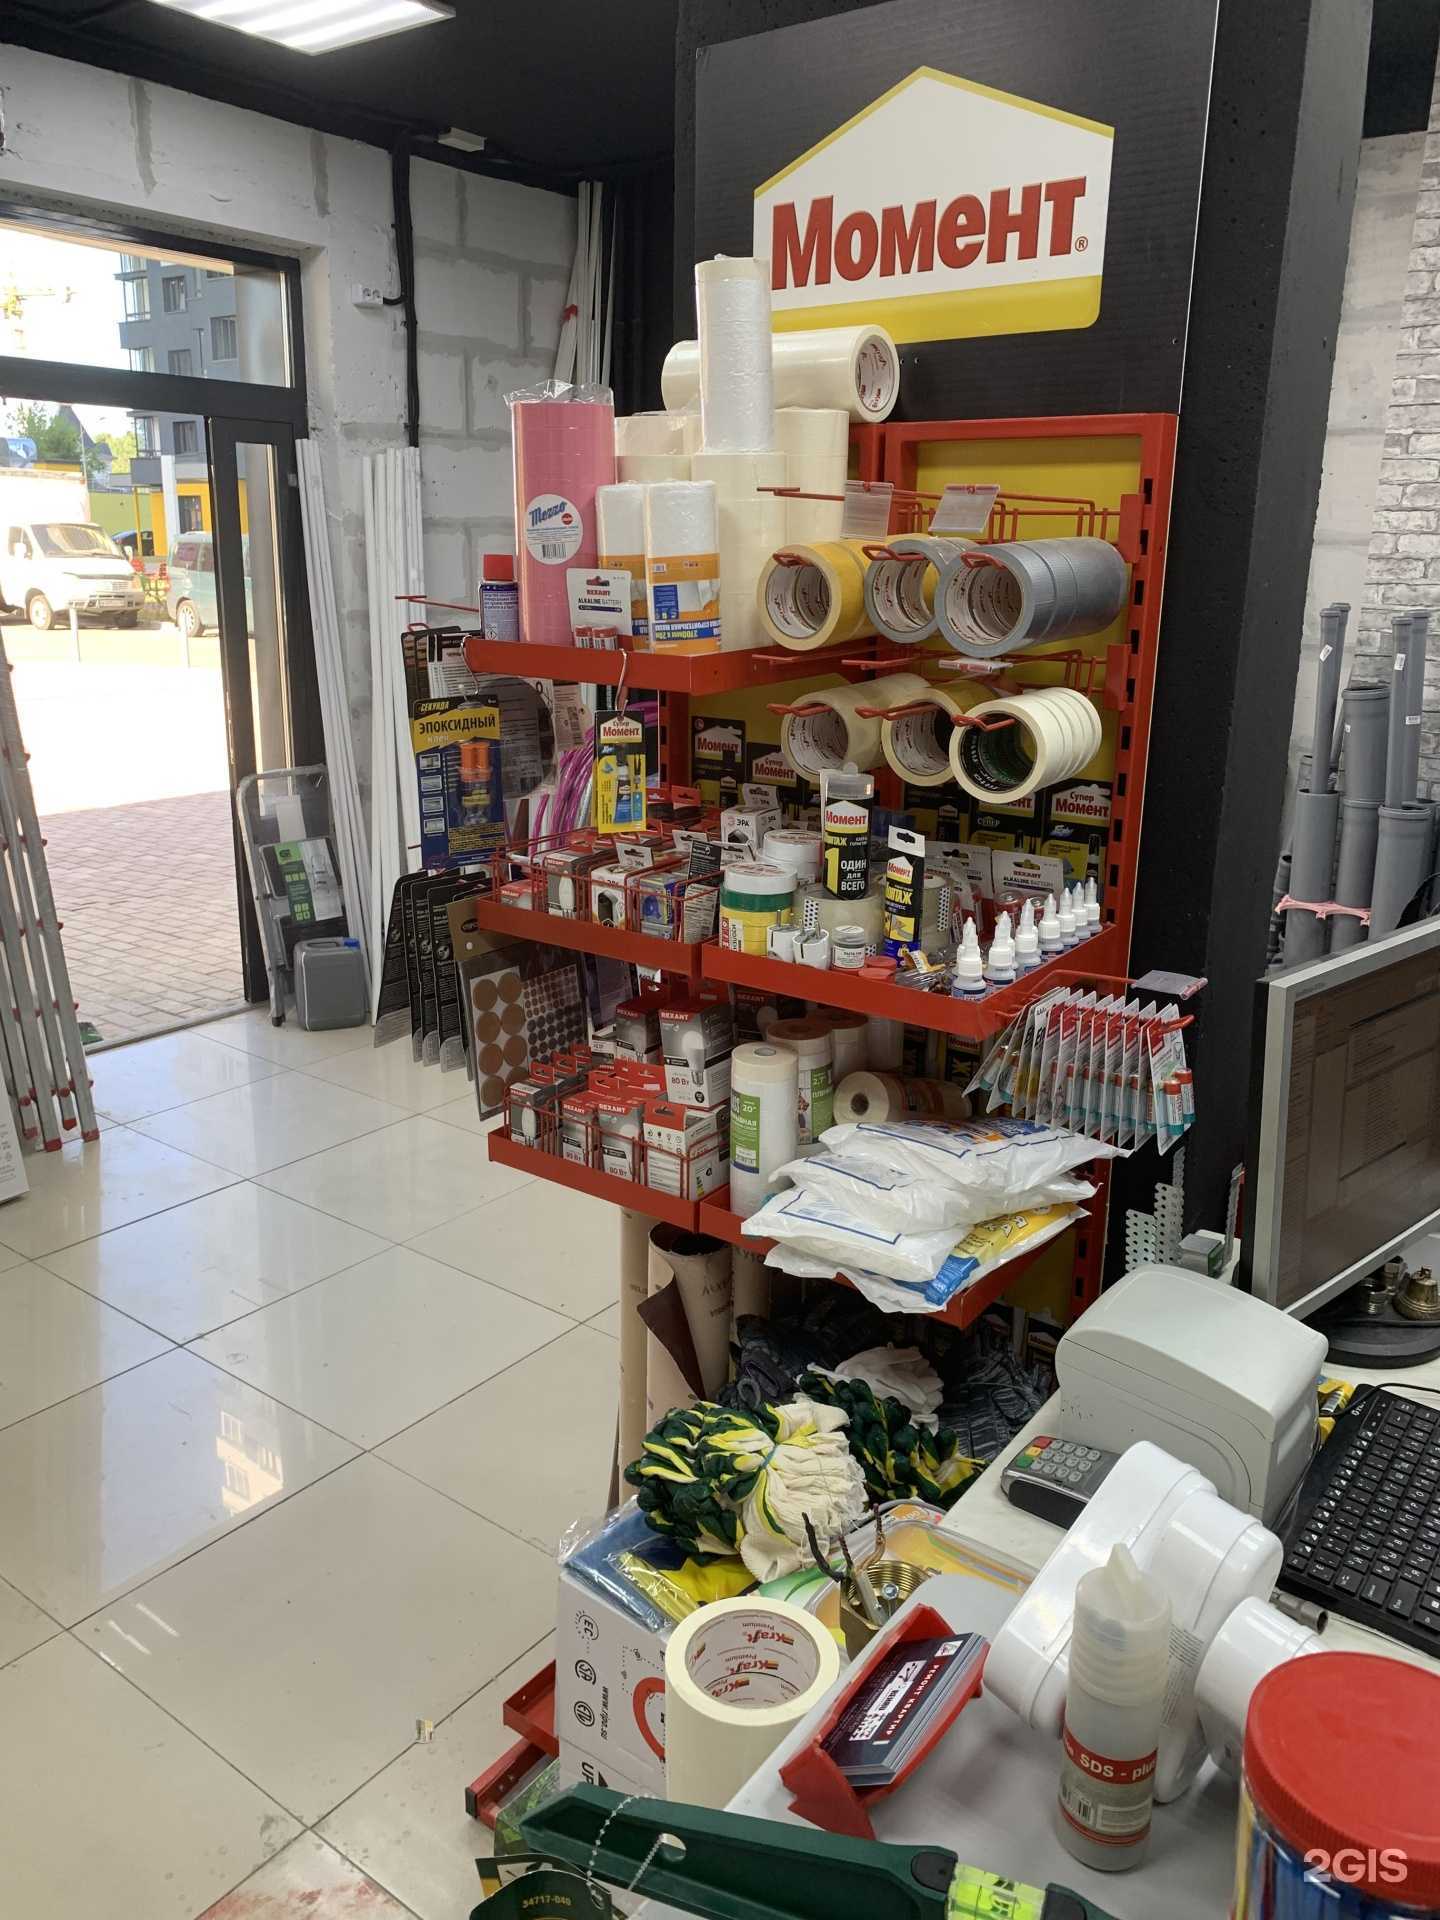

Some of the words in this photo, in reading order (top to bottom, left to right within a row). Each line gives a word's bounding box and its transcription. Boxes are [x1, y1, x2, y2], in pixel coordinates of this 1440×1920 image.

[771, 176, 1087, 291] Момент
[419, 713, 496, 734] ЭПОКСИДНЫЙ
[602, 727, 640, 737] Момент
[697, 736, 740, 753] Момент
[754, 762, 795, 779] Момент
[1070, 791, 1095, 802] Супер
[1055, 798, 1110, 818] Момент
[737, 819, 750, 827] ЭРА
[825, 810, 867, 825] Момент
[840, 859, 867, 871] ОДИН
[840, 880, 865, 891] ВСЕГО
[616, 1008, 639, 1017] REXANT
[661, 1011, 689, 1021] REXANT
[563, 1103, 585, 1114] REXANT
[599, 1103, 626, 1114] REXANT
[742, 1622, 775, 1630] Premium
[747, 1630, 785, 1643] Kraft
[724, 1653, 758, 1663] Premium
[729, 1660, 769, 1675] Kraft
[914, 1664, 940, 1695] РЕМОНТ
[886, 1698, 916, 1735] КВАРТИР
[1080, 1753, 1114, 1778] SDS
